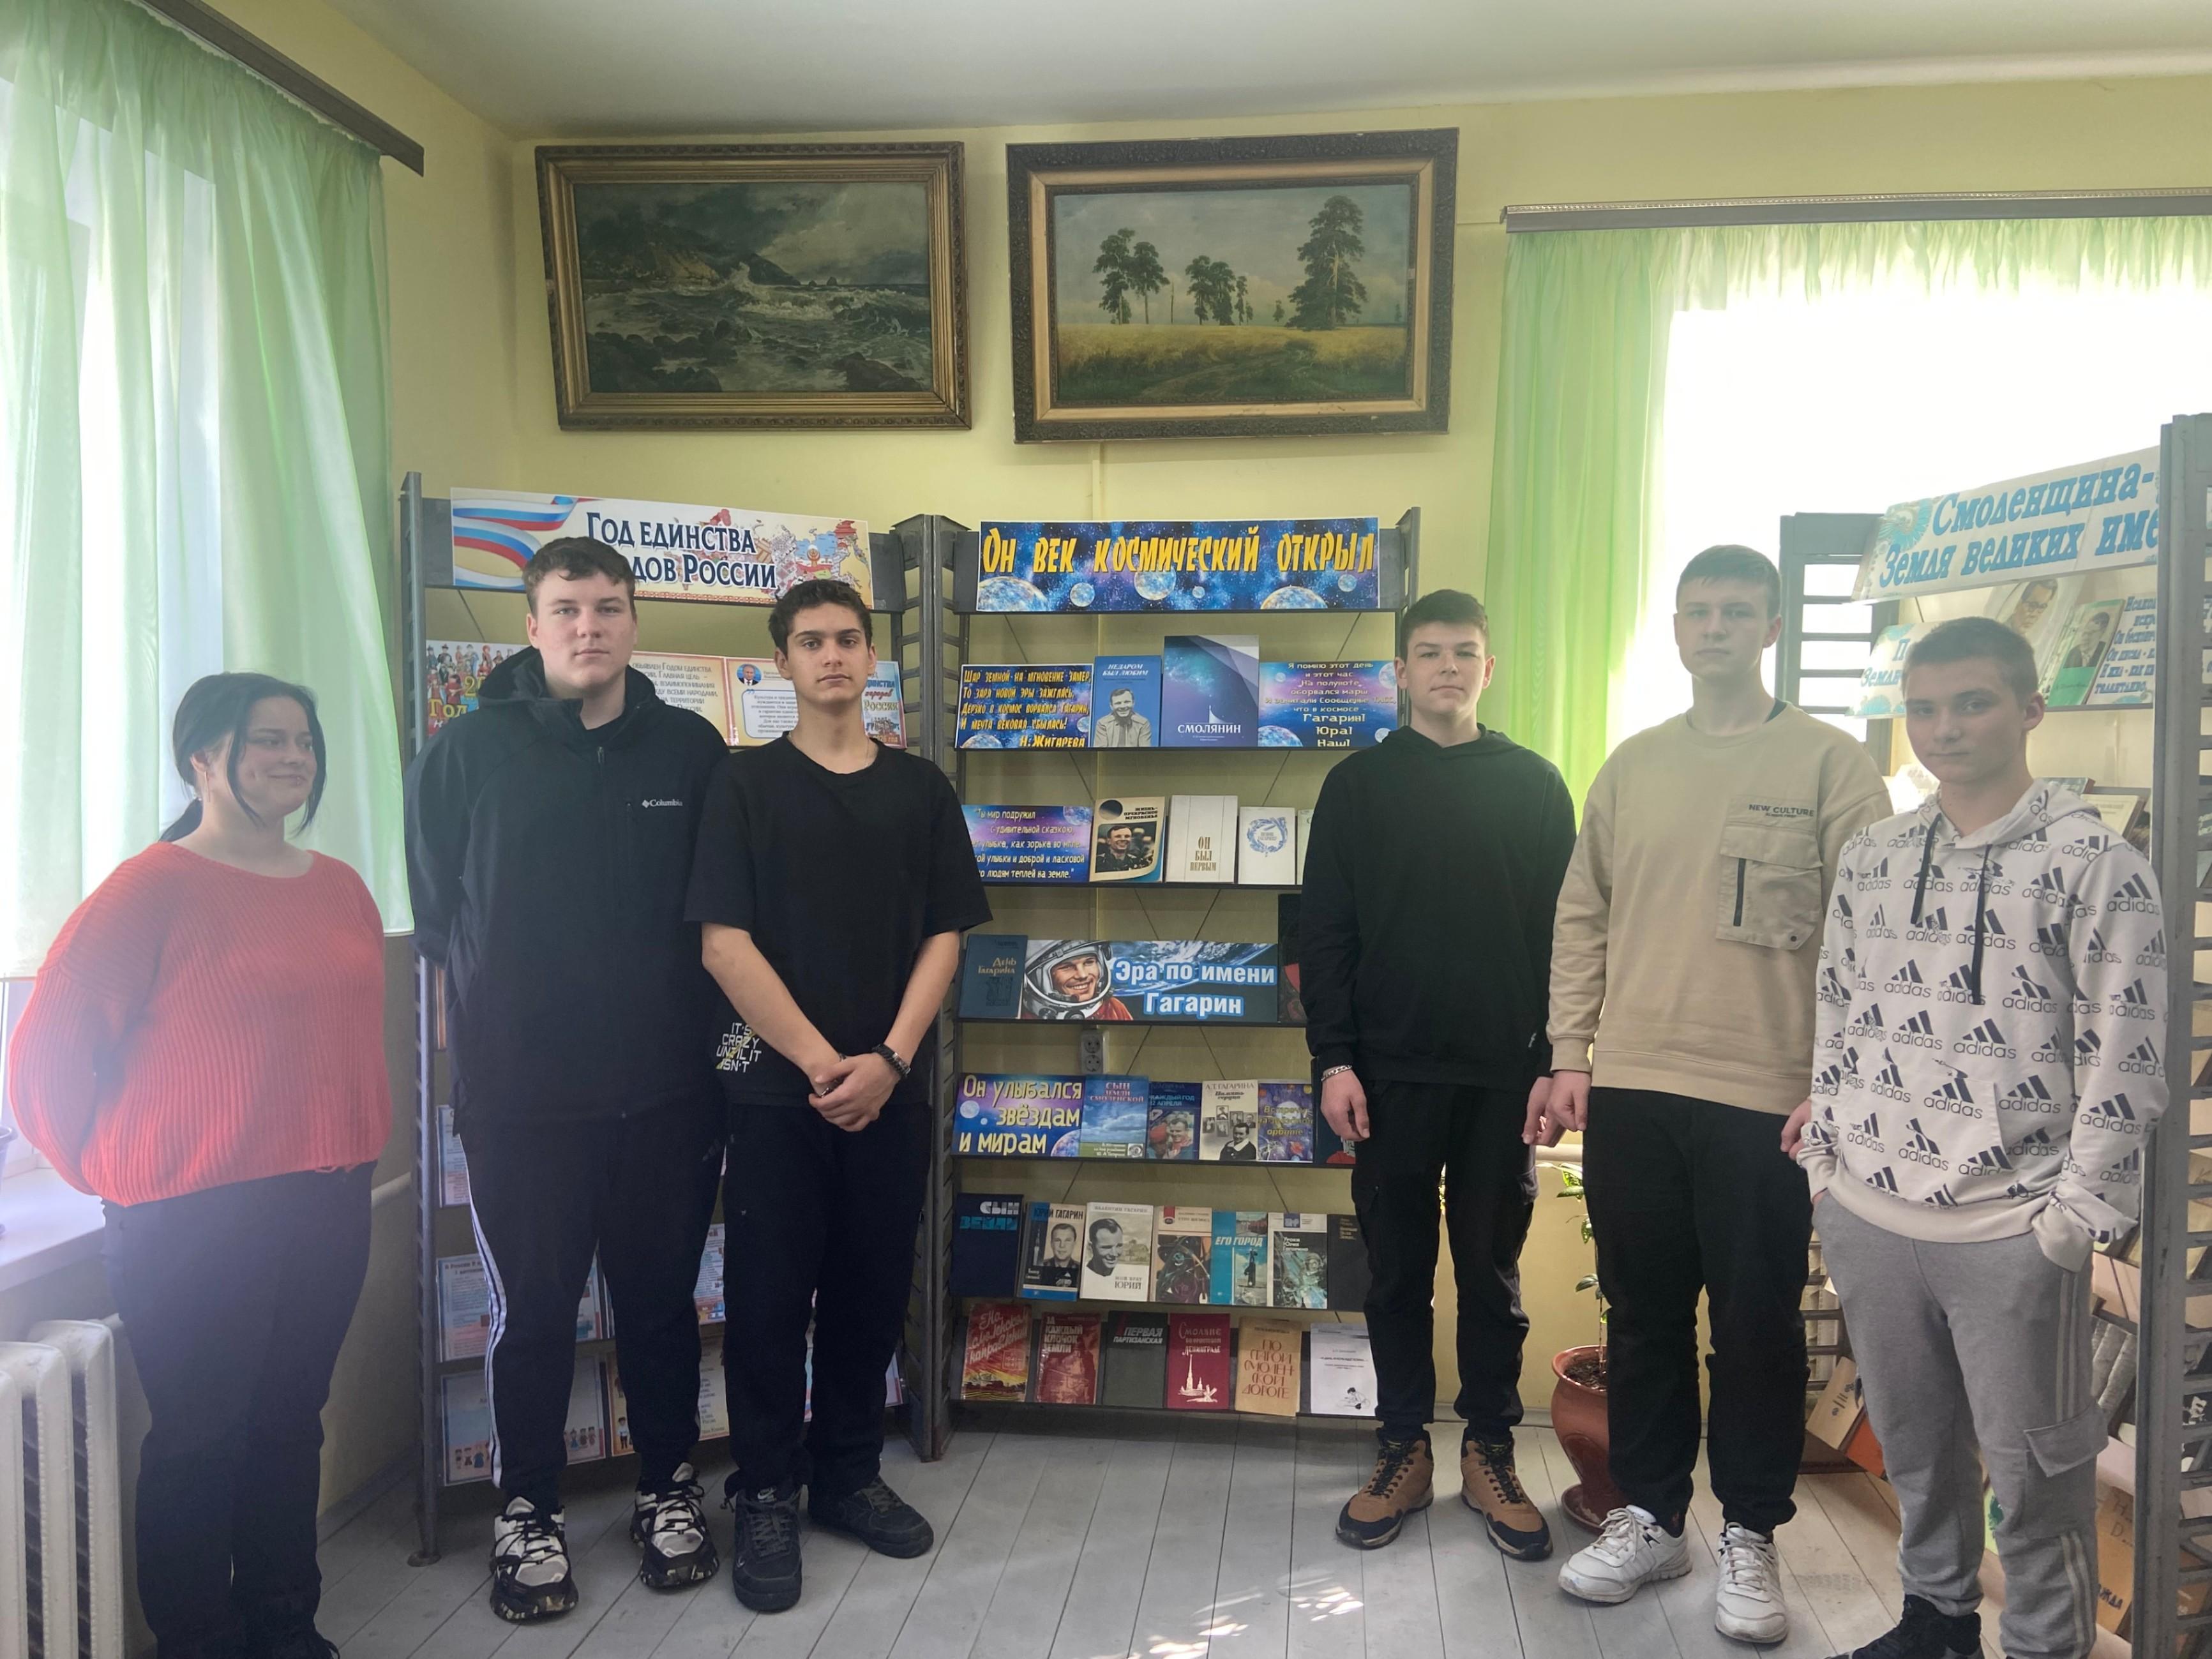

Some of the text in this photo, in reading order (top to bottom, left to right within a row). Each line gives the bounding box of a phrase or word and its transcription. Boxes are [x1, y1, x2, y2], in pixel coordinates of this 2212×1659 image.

[1932, 463, 2155, 536] Смоленщина-
[1032, 537, 1077, 573] ВЕК
[1094, 525, 1260, 573] КОСМИЧЕСКИЙ
[1277, 531, 1374, 573] ОТКРЫЛ
[1879, 509, 2158, 588] Земля великих име
[1303, 714, 1366, 724] Гагарин!
[1177, 724, 1241, 733] СМОЛЯНИН
[1316, 726, 1352, 737] Юра!
[1317, 739, 1350, 747] Наш!
[649, 799, 683, 807] Columbia
[1002, 811, 1035, 822] подружил
[1773, 807, 1814, 817] CULTURE
[1198, 836, 1211, 849] ОН
[987, 856, 1011, 866] улыбки
[1019, 854, 1044, 866] доброй
[1052, 854, 1085, 863] ласковой
[1194, 850, 1212, 862] БЫЛ
[1190, 862, 1216, 871] ПЕРВЫМ
[987, 871, 1009, 879] людям
[1011, 869, 1035, 878] теплей
[1116, 960, 1275, 985] Эра по имени
[1146, 993, 1242, 1017] Гагарин
[722, 1033, 760, 1049] CRAZY
[1892, 1032, 1943, 1051] adidas
[749, 1049, 762, 1062] IT
[1953, 1041, 2017, 1060] adidas
[963, 1074, 1083, 1107] Он улыбался
[1923, 1096, 1983, 1119] adidas
[1998, 1097, 2061, 1115] adidas
[996, 1104, 1081, 1129] звёздам
[2080, 1113, 2142, 1135] adidas
[959, 1132, 1047, 1155] и мирам
[1899, 1147, 1950, 1171] adidas
[980, 1201, 1020, 1215] СЫН
[1055, 1209, 1084, 1220] ГАГАРИН
[1215, 1236, 1263, 1247] ЕГО ГОРОД
[1115, 1281, 1142, 1290] ЮРИЙ
[1124, 1327, 1163, 1337] ПЕРВАЯ
[1262, 1339, 1282, 1351] ПО
